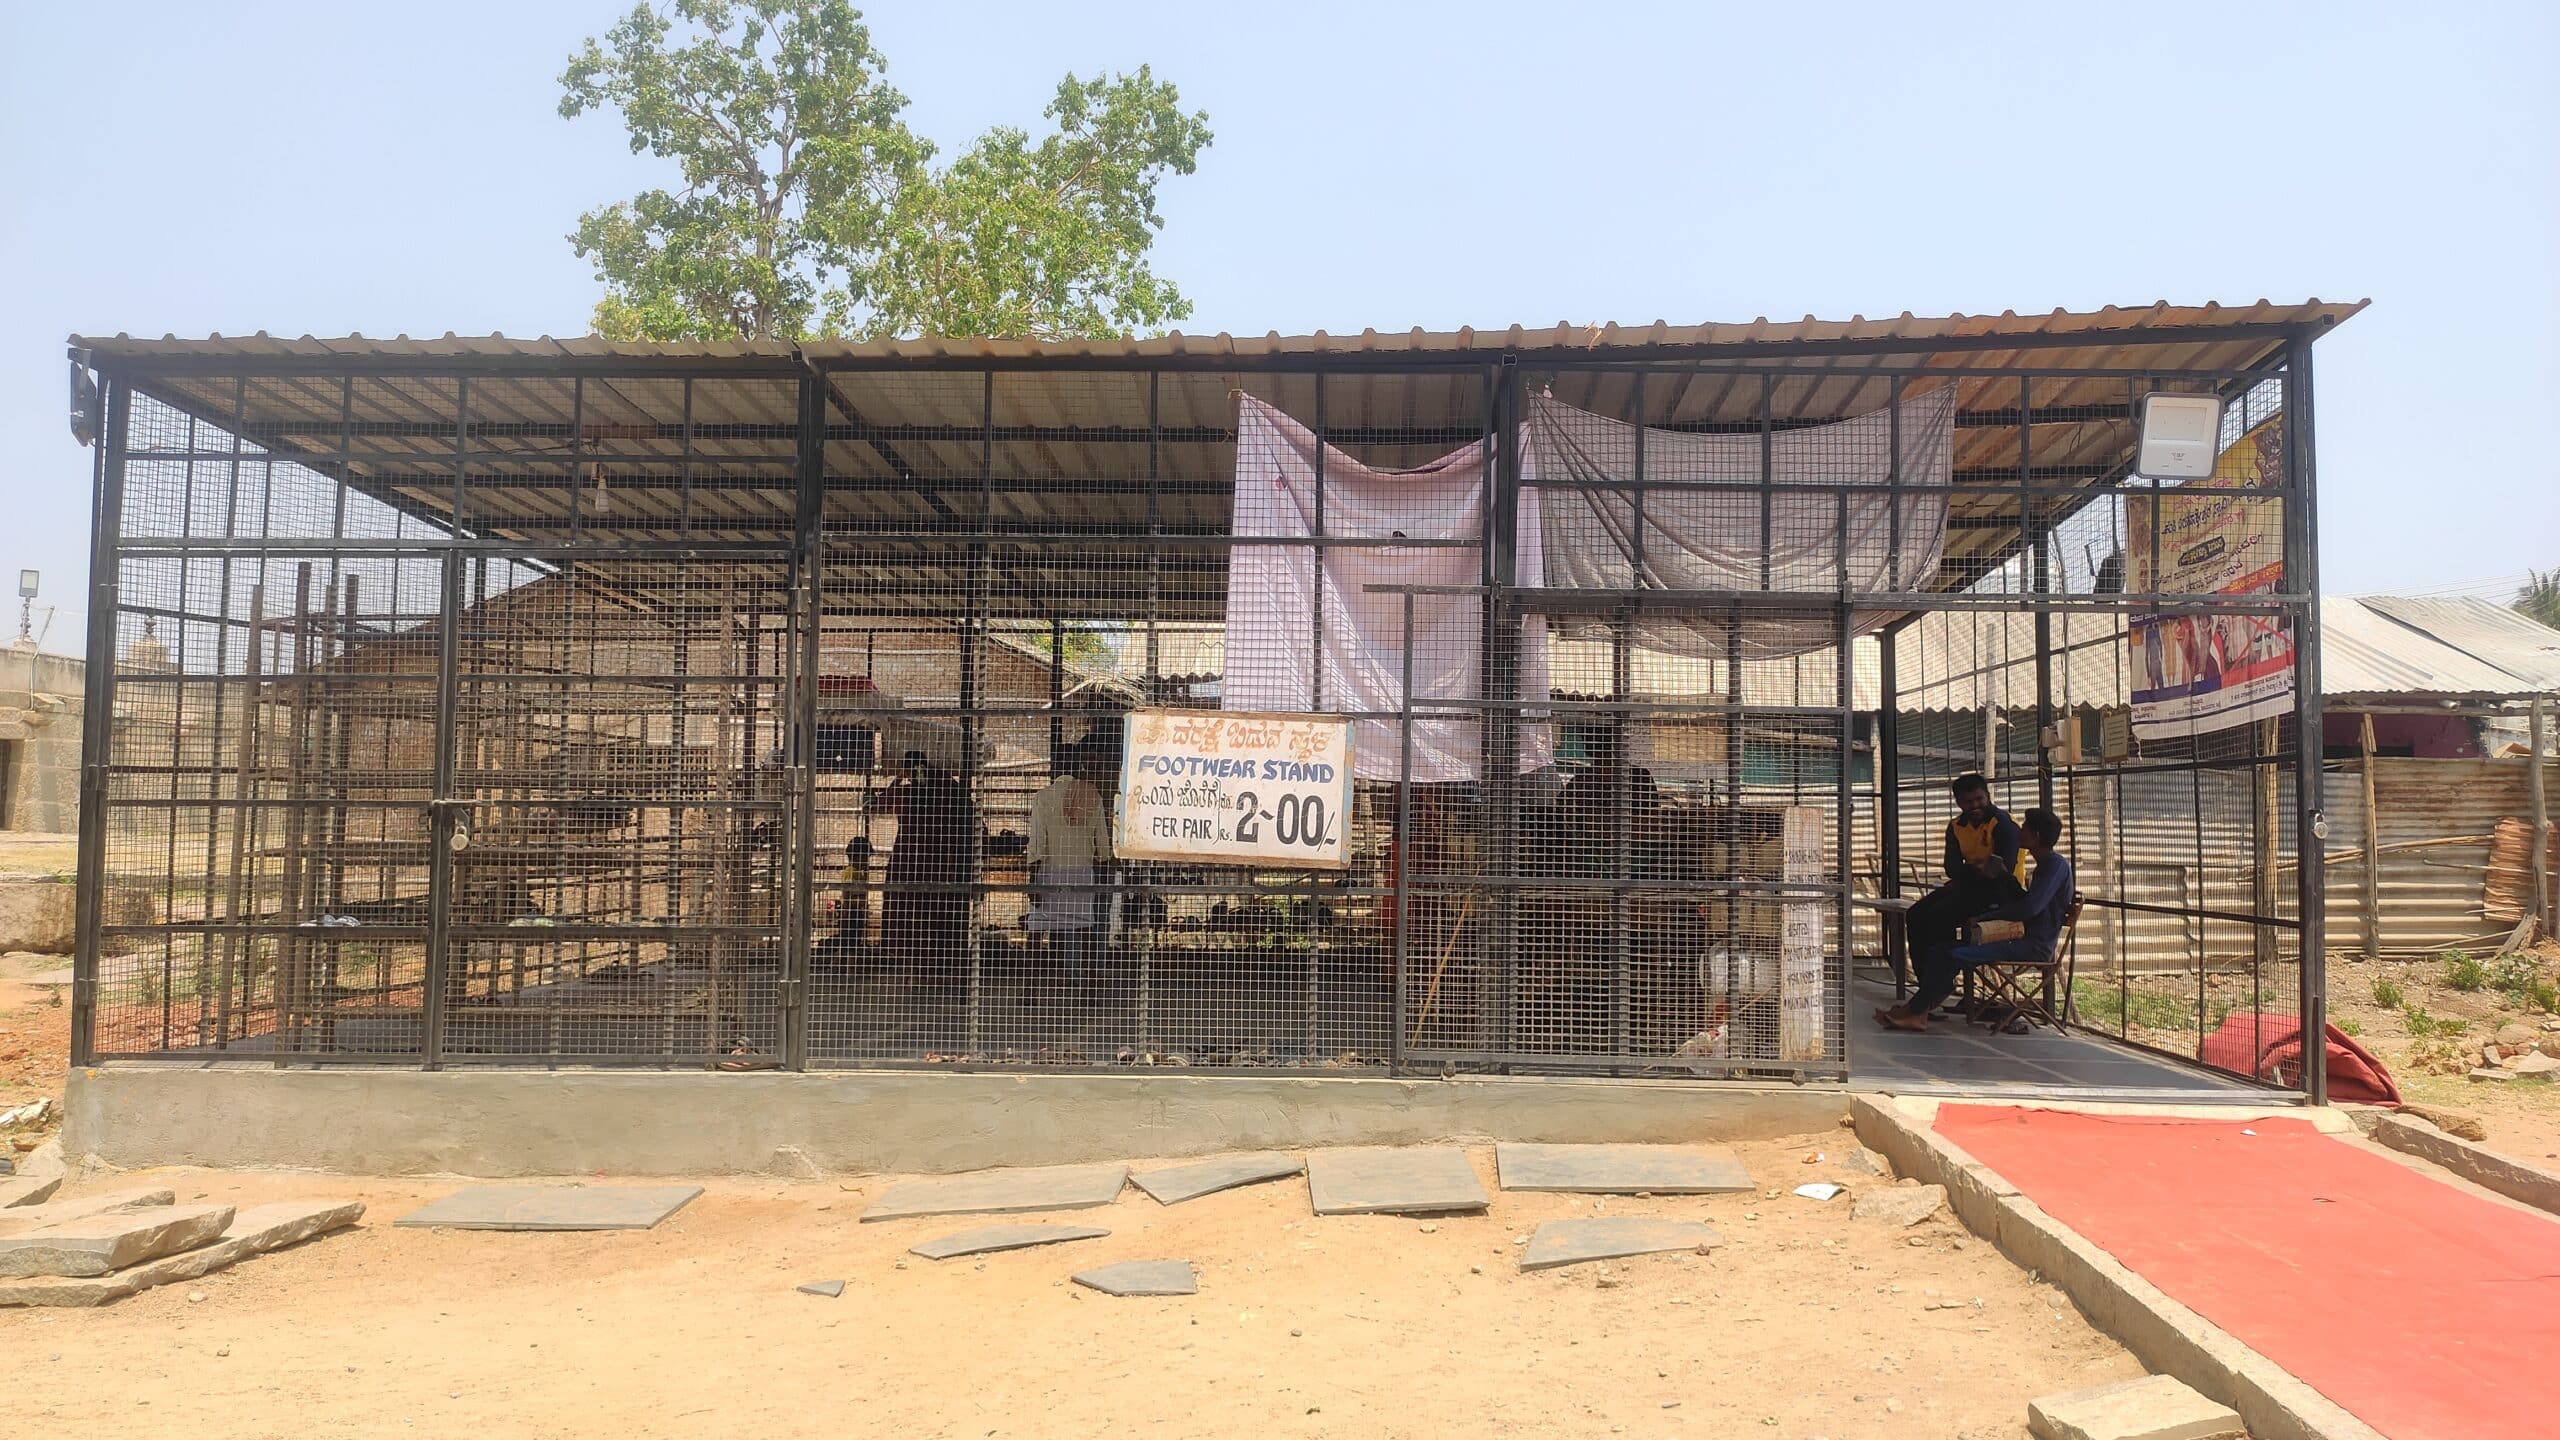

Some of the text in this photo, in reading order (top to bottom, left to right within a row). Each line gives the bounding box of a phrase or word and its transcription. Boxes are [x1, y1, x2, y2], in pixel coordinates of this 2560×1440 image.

[1138, 755, 1335, 784] FOOTWEAR STAND
[1152, 817, 1178, 838] PER
[1183, 818, 1212, 839] PAIR
